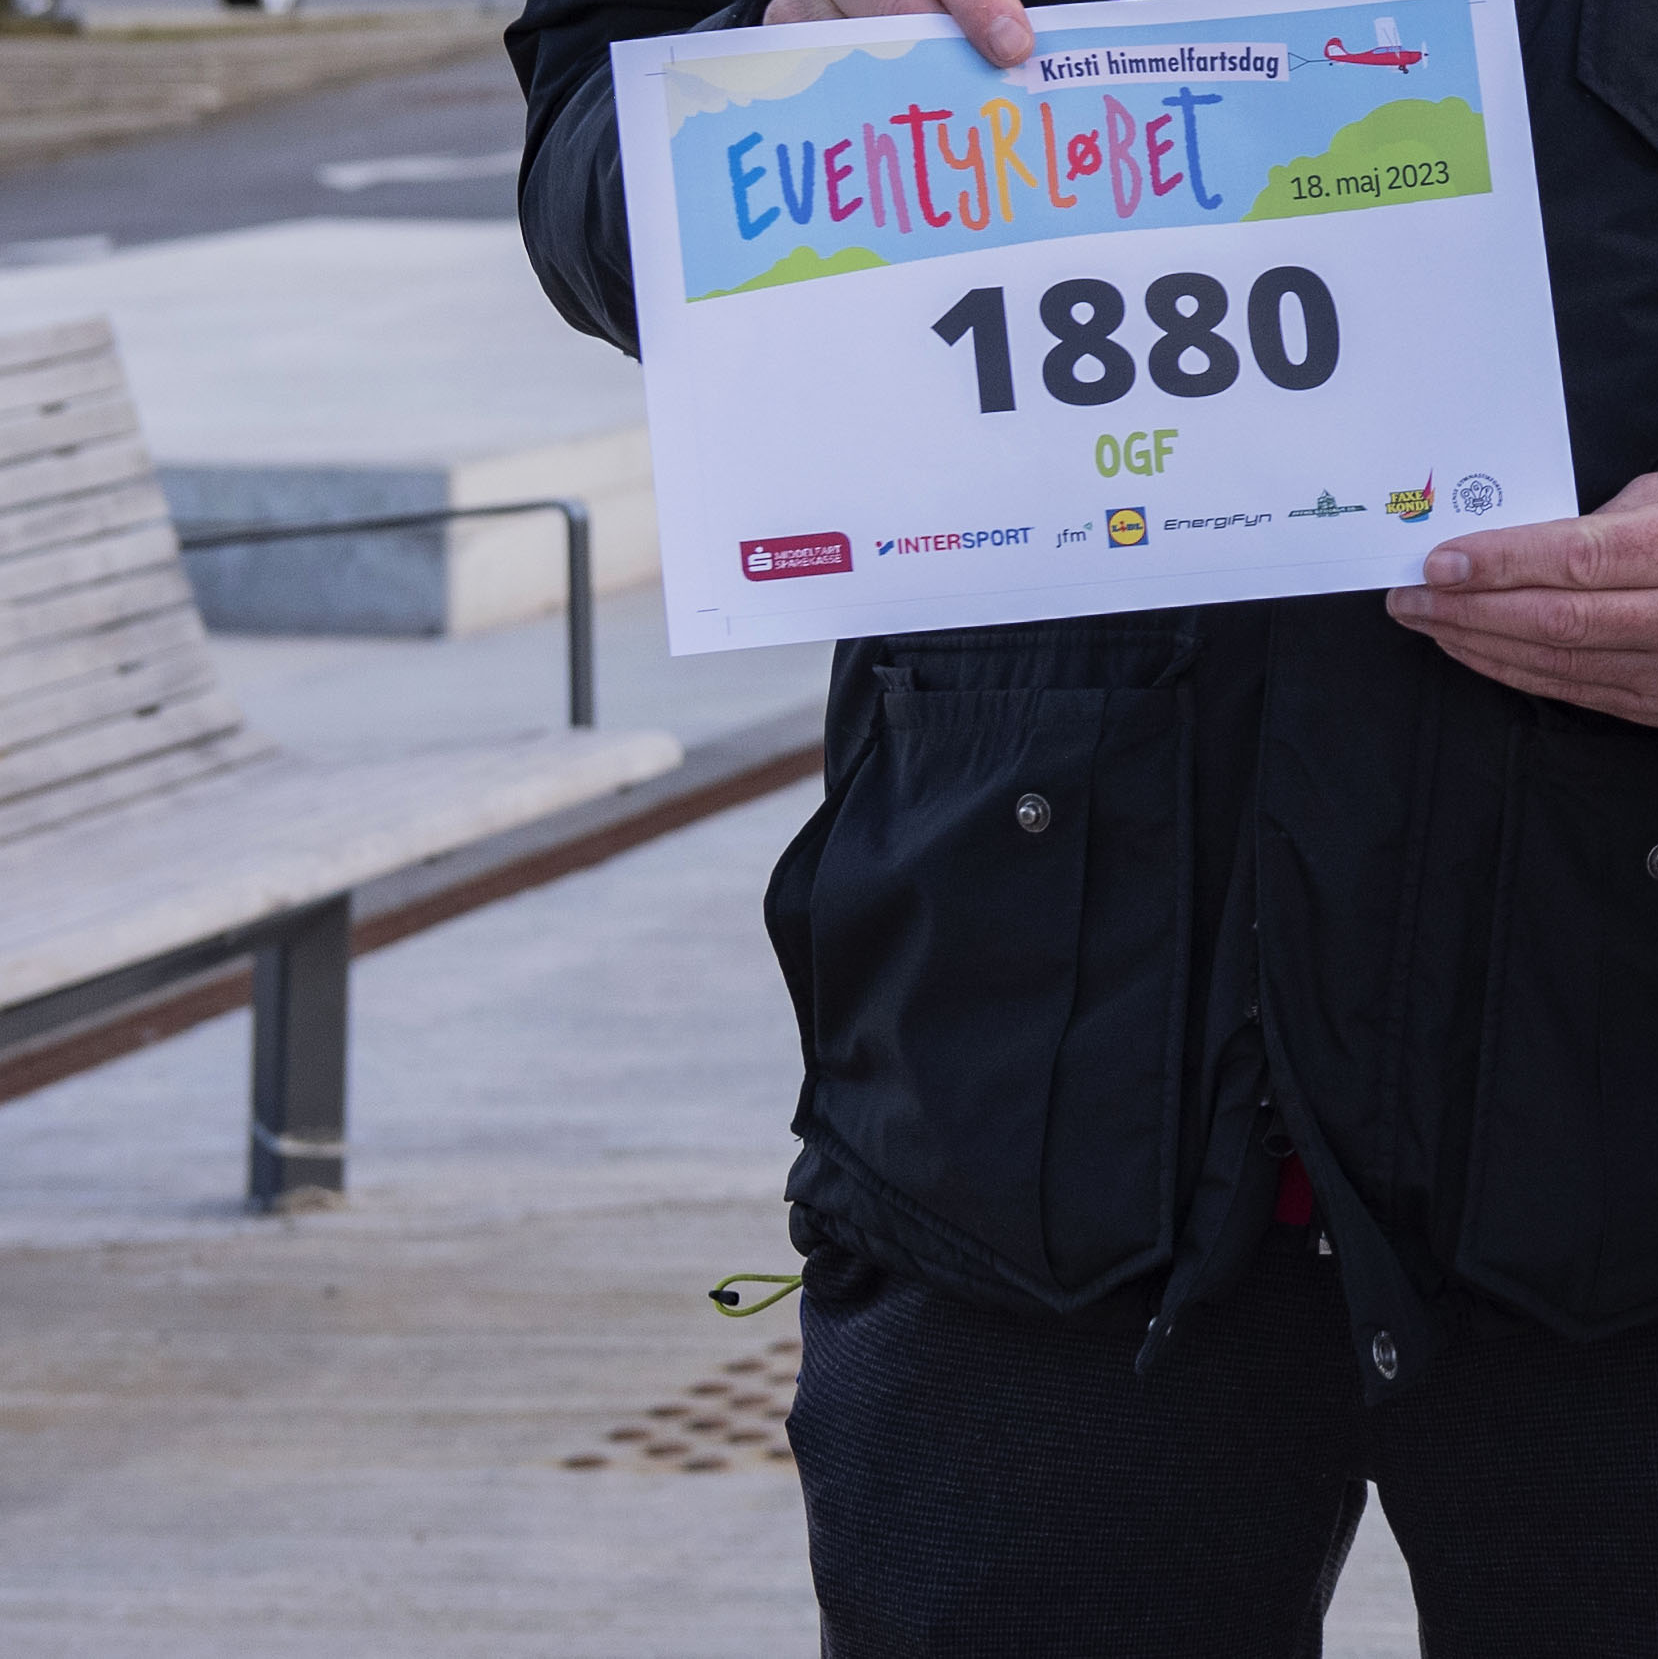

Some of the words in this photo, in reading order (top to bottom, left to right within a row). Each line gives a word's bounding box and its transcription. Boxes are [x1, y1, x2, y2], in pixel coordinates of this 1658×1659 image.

[1040, 51, 1100, 83] Kristi
[1108, 44, 1281, 80] himmelfartsdag
[1291, 175, 1332, 201] 18.
[1337, 169, 1381, 198] maj
[1387, 160, 1450, 192] 2023
[931, 265, 1340, 413] 1880
[1095, 429, 1179, 478] OGF
[1386, 500, 1430, 514] KONDI
[1390, 490, 1424, 503] FAXE
[897, 528, 1035, 554] INTERSPORT
[1056, 528, 1087, 548] jfm
